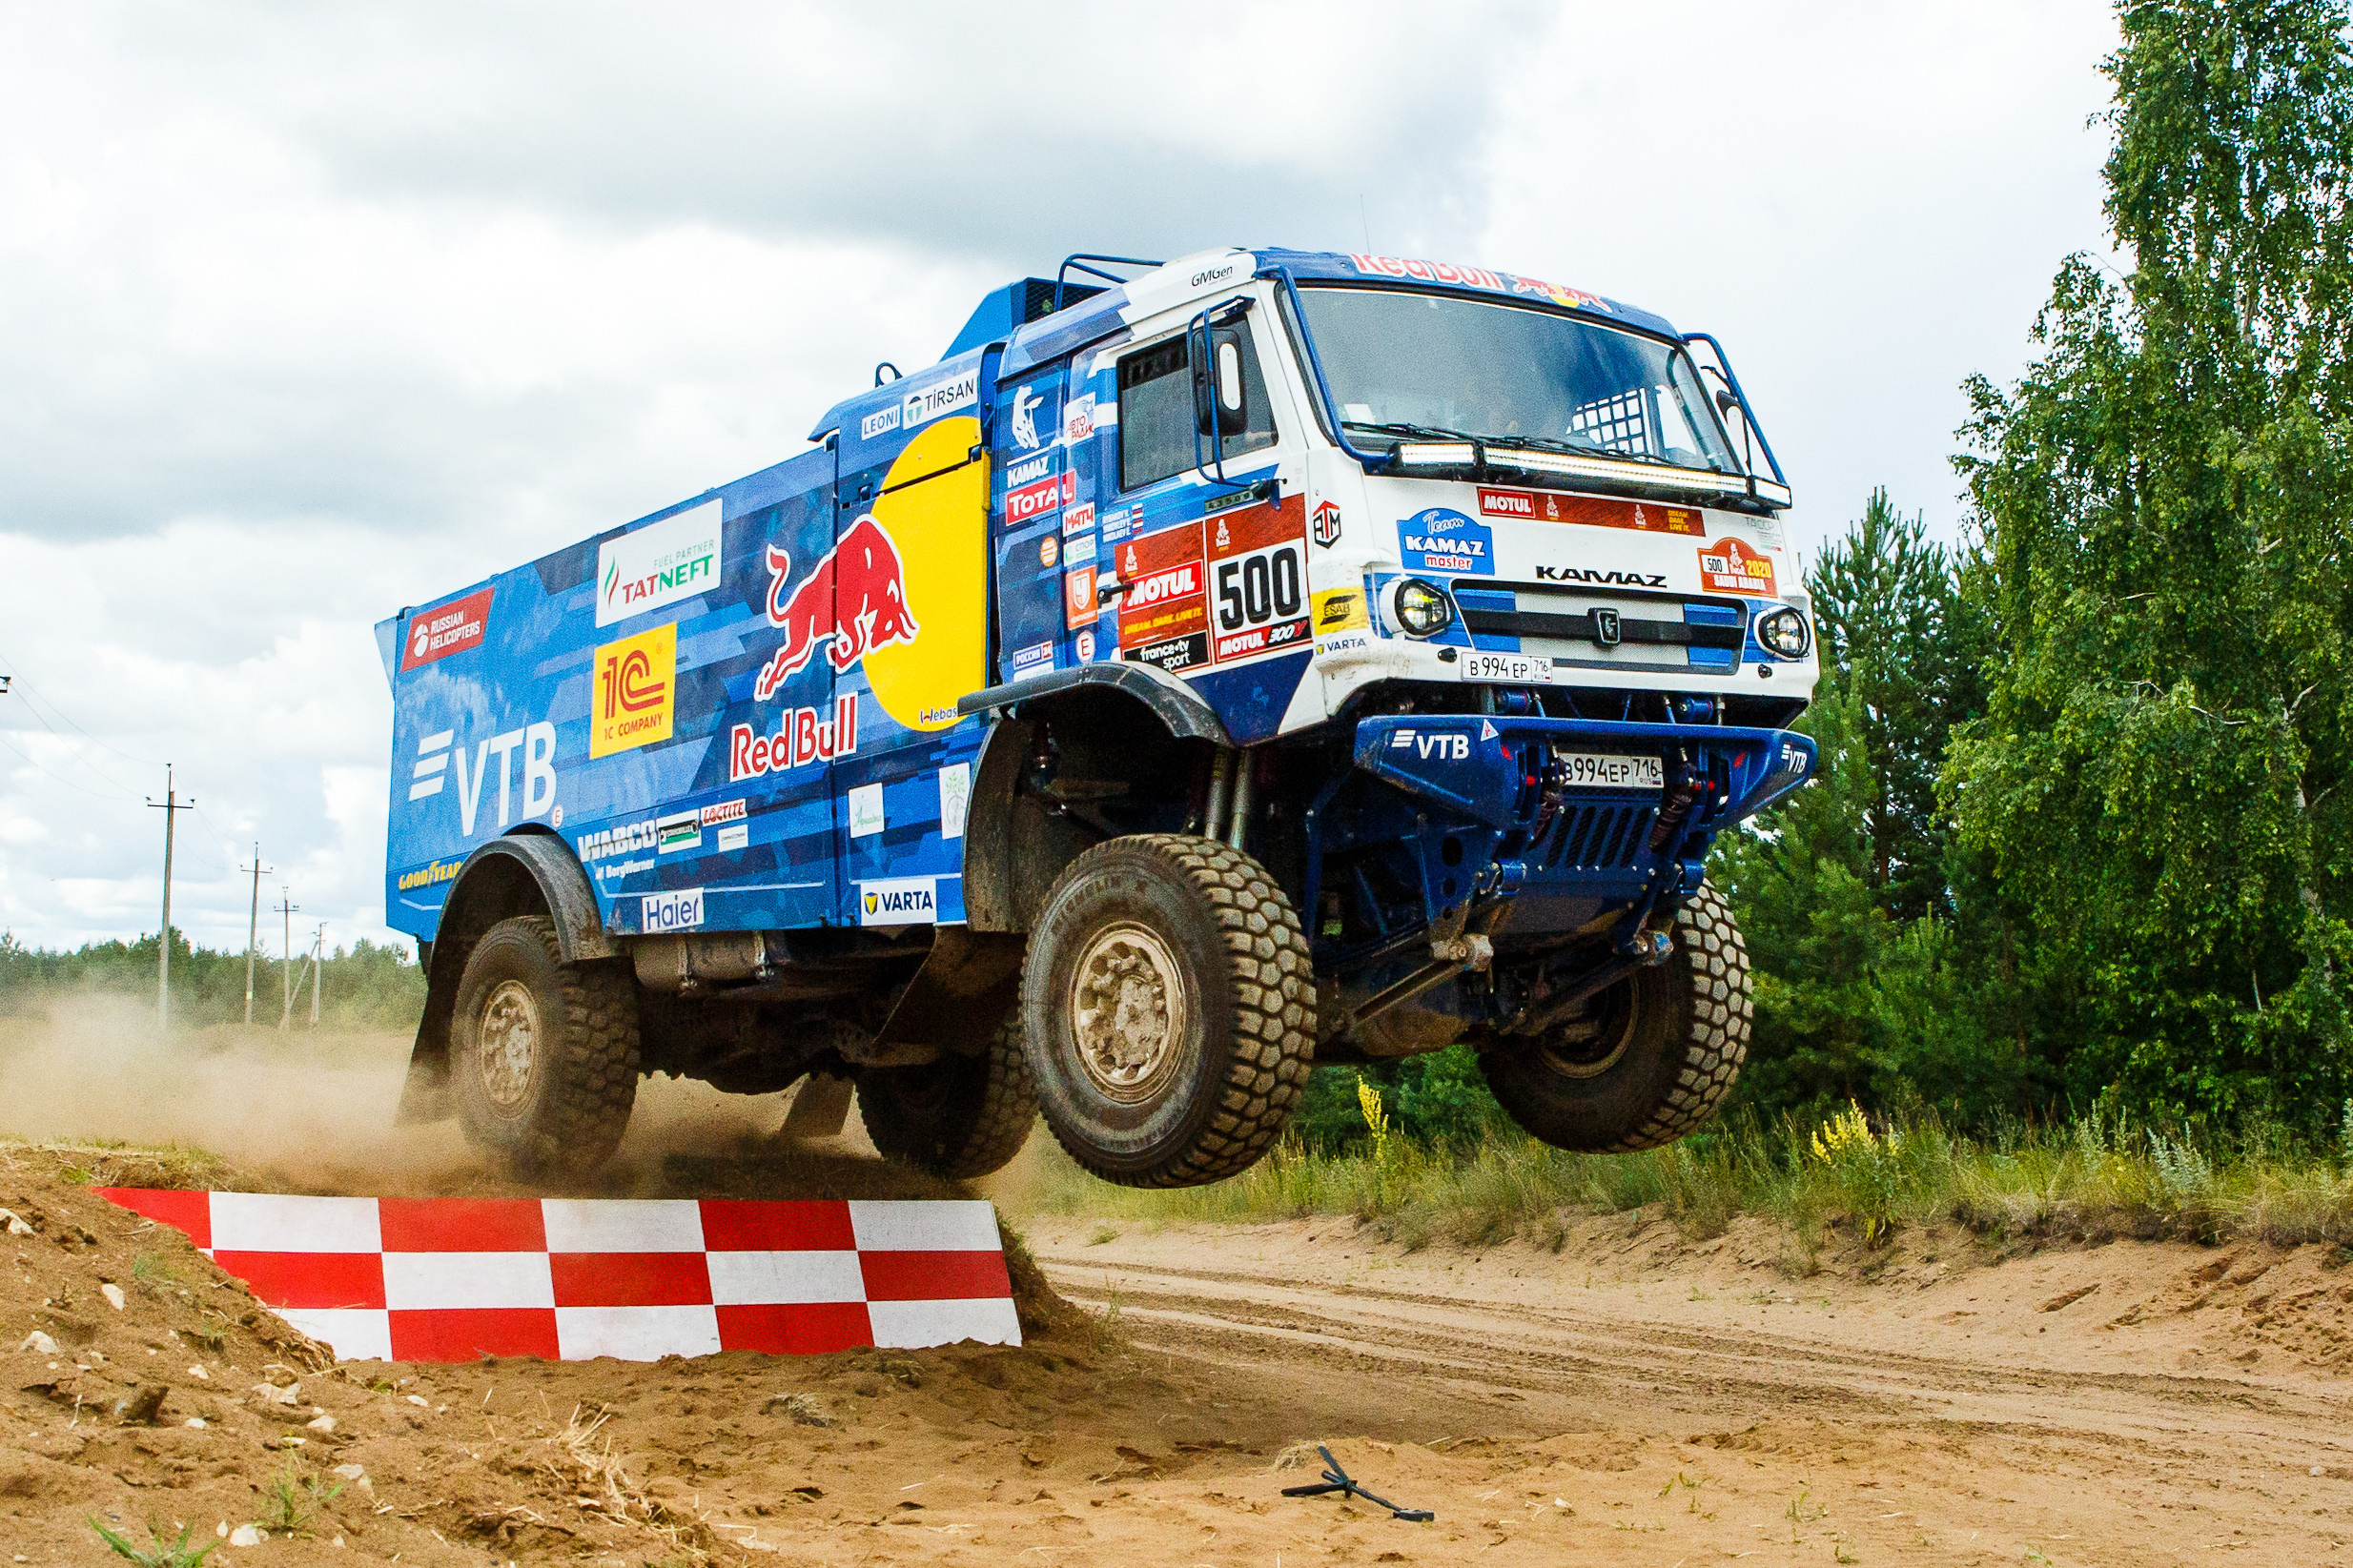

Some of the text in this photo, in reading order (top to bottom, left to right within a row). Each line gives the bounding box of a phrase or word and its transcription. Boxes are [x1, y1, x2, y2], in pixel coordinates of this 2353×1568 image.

[1191, 266, 1233, 287] GMGen
[863, 413, 899, 436] LEONI
[1007, 456, 1049, 489] KAMAZ
[1009, 487, 1074, 517] TOTAL
[1484, 496, 1531, 514] MOTUL
[1422, 510, 1464, 535] Team
[653, 539, 715, 569] FUEL PARTNER
[1404, 535, 1485, 557] KAMAZ
[1425, 555, 1472, 570] master
[1708, 558, 1772, 579] 500 2020
[622, 554, 714, 604] TATNEFT
[1127, 567, 1196, 607] MOTUL
[1217, 547, 1301, 631] 500
[1535, 565, 1668, 589] KAMAZ
[430, 610, 464, 634] RUSSIAN
[1324, 603, 1350, 618] ESAB
[429, 621, 481, 652] HELICOPTERS
[1219, 620, 1305, 657] MOTUL 300V
[1326, 638, 1367, 652] VARTA
[1163, 651, 1191, 672] sport
[603, 649, 665, 720] 1C
[604, 712, 664, 742] 1C COMPANY
[920, 707, 957, 724] Webas
[1415, 732, 1470, 760] VTB
[1632, 758, 1658, 778] 716
[1787, 749, 1808, 773] VTB
[455, 721, 557, 837] VTB
[704, 802, 745, 825] LOCTITE
[577, 820, 658, 863] WABCO
[646, 894, 699, 931] Haier
[882, 890, 933, 911] VARTA
